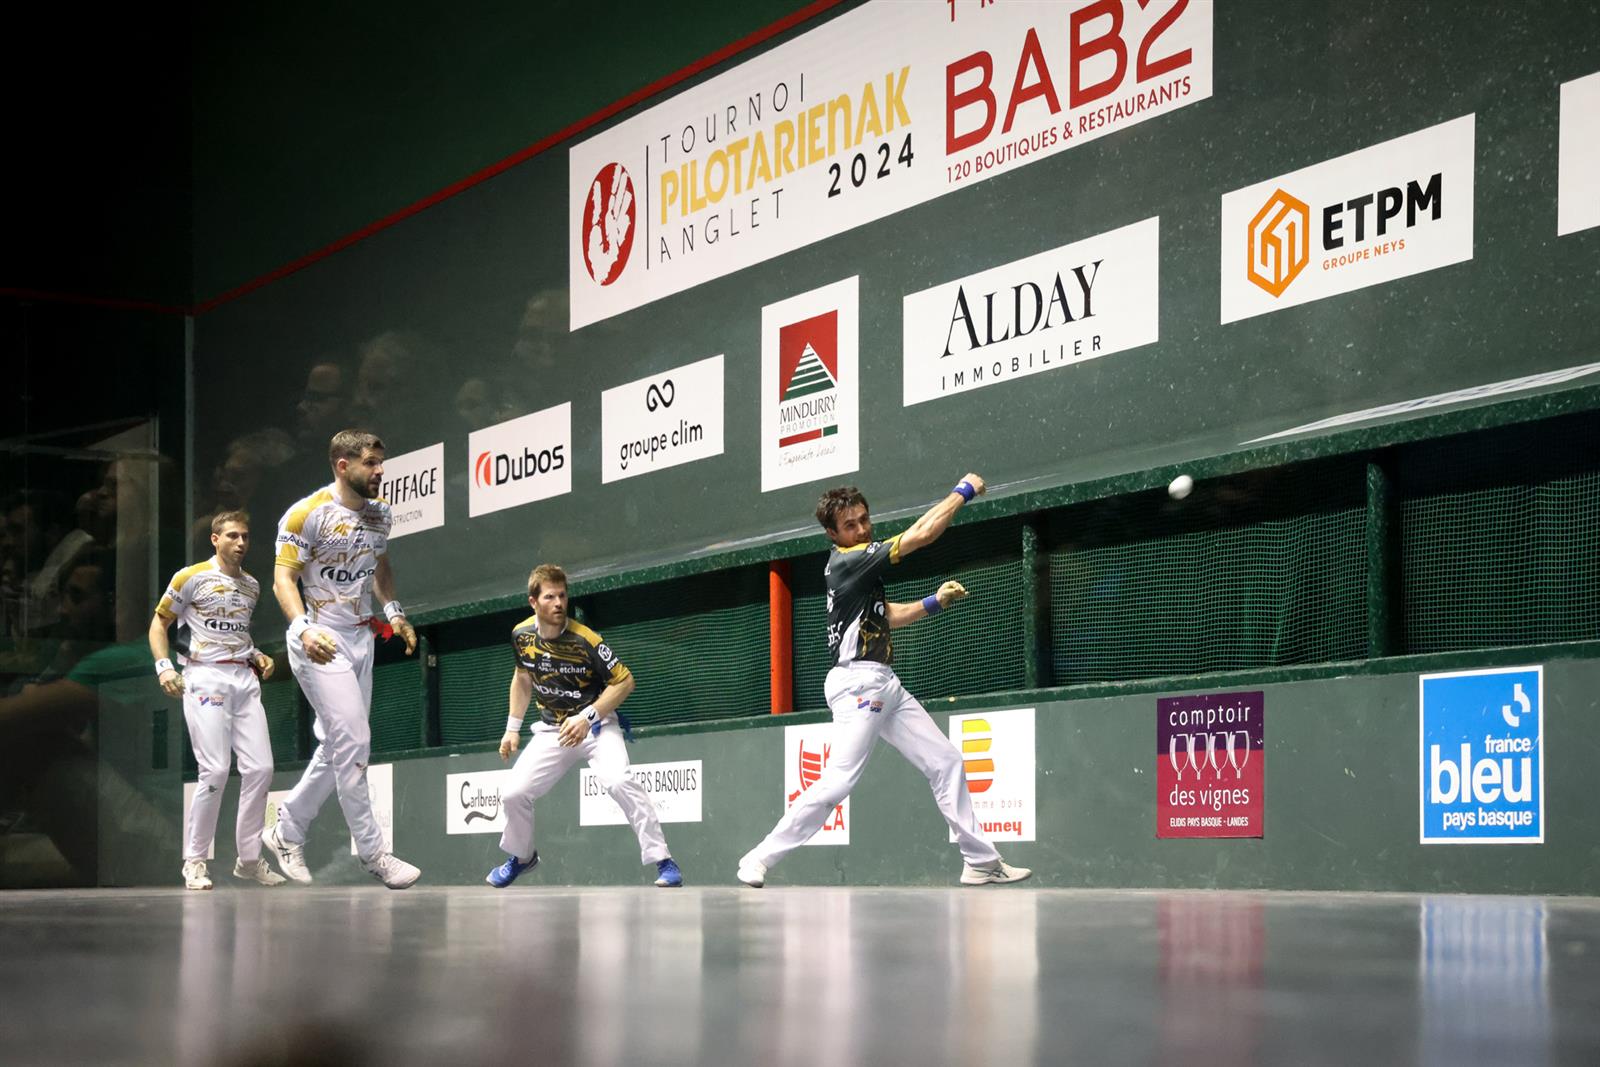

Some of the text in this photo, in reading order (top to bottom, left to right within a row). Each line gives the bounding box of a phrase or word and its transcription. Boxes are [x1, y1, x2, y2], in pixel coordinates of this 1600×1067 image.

[946, 0, 1192, 156] BAB2
[660, 73, 804, 163] TOURNOI
[947, 76, 1192, 183] 120 BOUTIQUES & RESTAURANTS
[828, 133, 914, 198] 2024
[660, 189, 784, 263] ANGLET
[1323, 172, 1442, 251] ETPM
[1323, 239, 1405, 270] GROUPE NEYS
[940, 259, 1104, 359] ALDAY
[942, 335, 1101, 390] IMMOBILIER
[780, 394, 838, 424] MINDURRY
[780, 414, 835, 434] PROMOTION
[620, 419, 703, 470] groupe clim
[495, 445, 564, 486] Dubos
[560, 665, 586, 674] etchart
[1169, 701, 1251, 730] comptoir
[1485, 734, 1532, 753] france
[584, 775, 598, 796] LES
[655, 768, 697, 794] BASQUES
[1430, 742, 1533, 805] bleu
[1169, 783, 1250, 811] des vignes
[1187, 818, 1200, 827] PAYS
[1201, 817, 1223, 827] BASQUE
[1227, 817, 1249, 826] LANDES
[1443, 807, 1533, 831] pays basque
